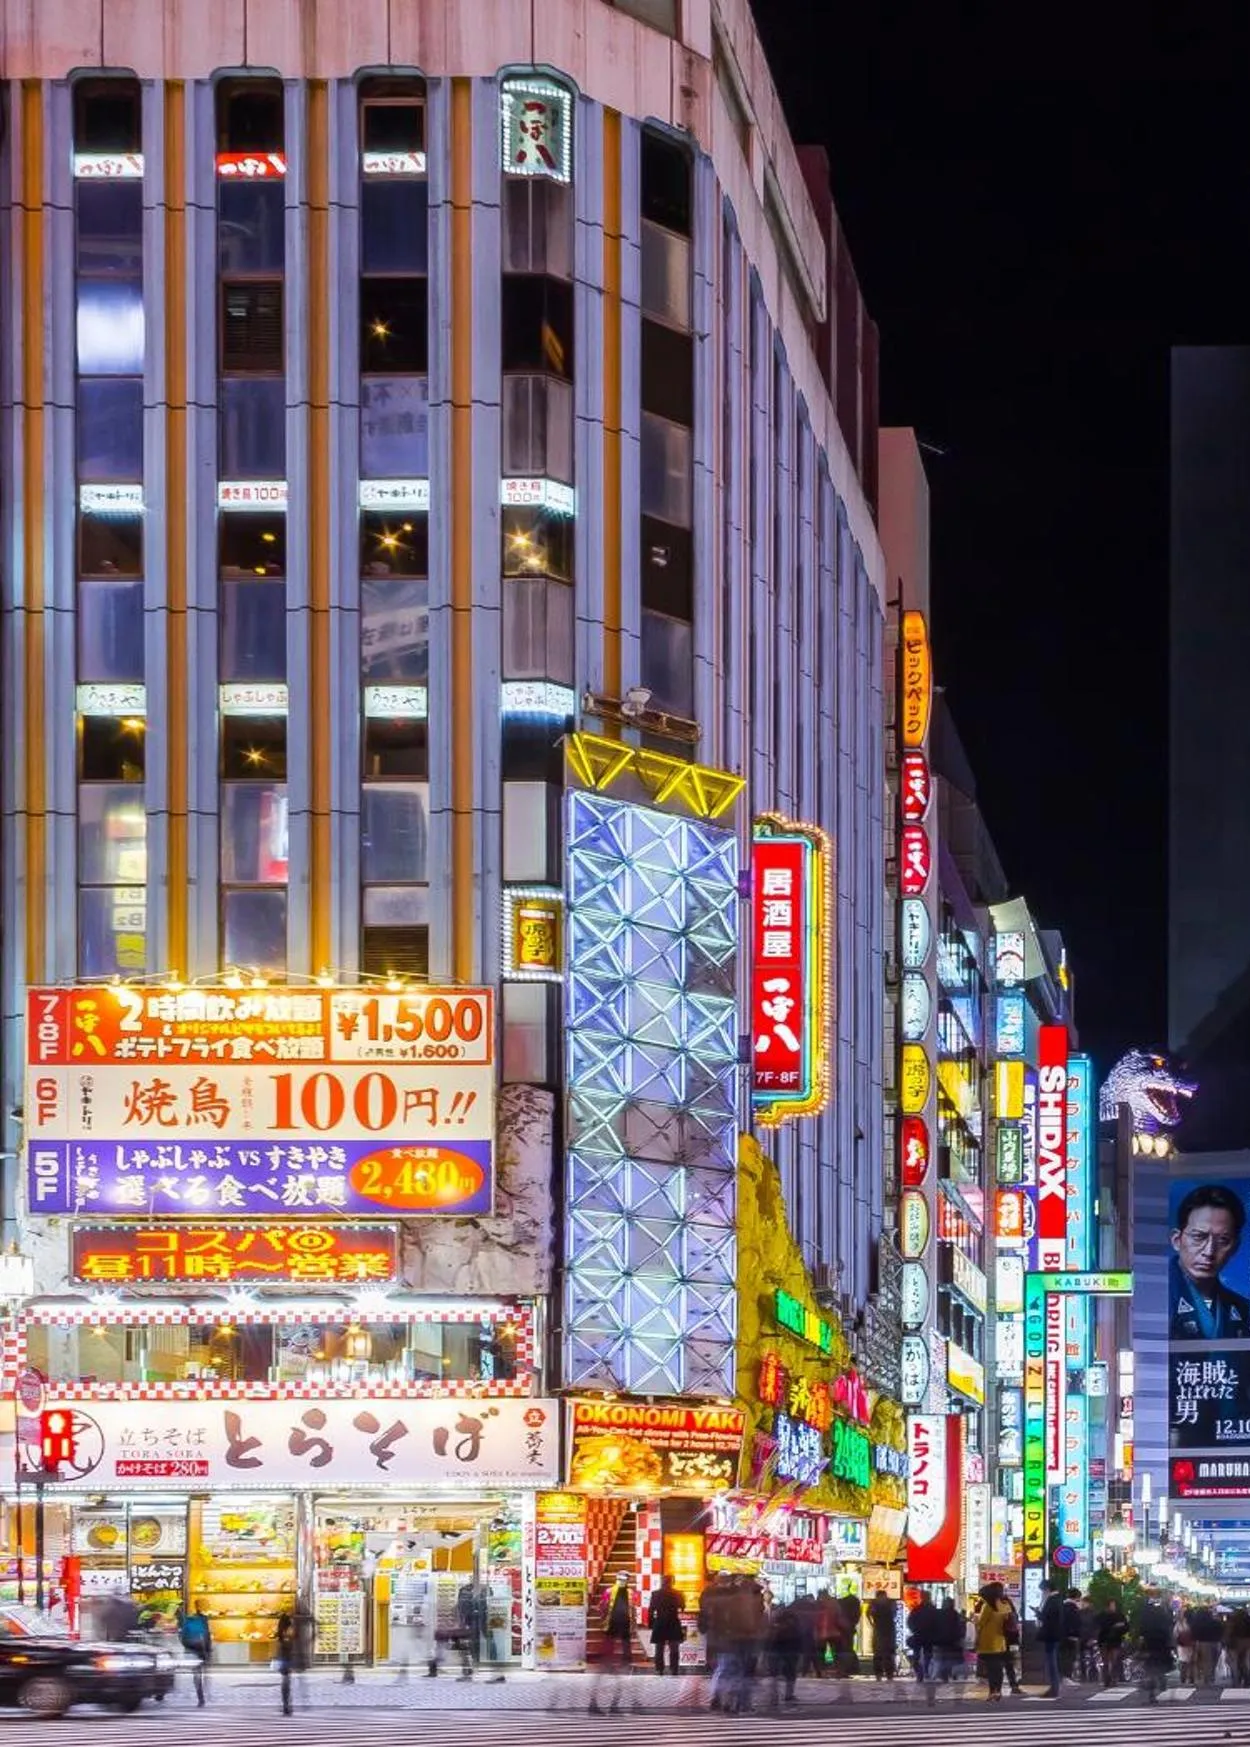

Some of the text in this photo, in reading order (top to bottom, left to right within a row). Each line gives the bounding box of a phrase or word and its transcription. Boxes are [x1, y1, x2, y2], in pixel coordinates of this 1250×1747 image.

[763, 869, 793, 958] 居酒屋
[72, 999, 106, 1056] つぼ八
[337, 998, 482, 1041] ¥1,500
[755, 978, 800, 1052] つぼ八
[115, 1037, 324, 1060] ポテトフライ食べ放題
[36, 1077, 58, 1126] 6F
[122, 1076, 231, 1130] 焼鳥
[1039, 1065, 1066, 1200] SHIDAX
[34, 1151, 59, 1201] 5F
[116, 1145, 231, 1171] しゃぶしゃぶ
[266, 1145, 347, 1170] すきやき
[1176, 1360, 1239, 1386] 海賊と
[1176, 1385, 1233, 1399] よばれた
[576, 1405, 744, 1430] OKONOMI YAKI
[1028, 1314, 1042, 1521] GODZILLA ROAD
[1172, 1400, 1199, 1424] 男
[120, 1428, 208, 1446] 立ちそば
[121, 1450, 204, 1459] TORA SOBA
[224, 1404, 500, 1469] とらそば
[117, 1463, 166, 1475] かけそば
[913, 1423, 929, 1495] トラノコ
[866, 1579, 898, 1590] トラノコ
